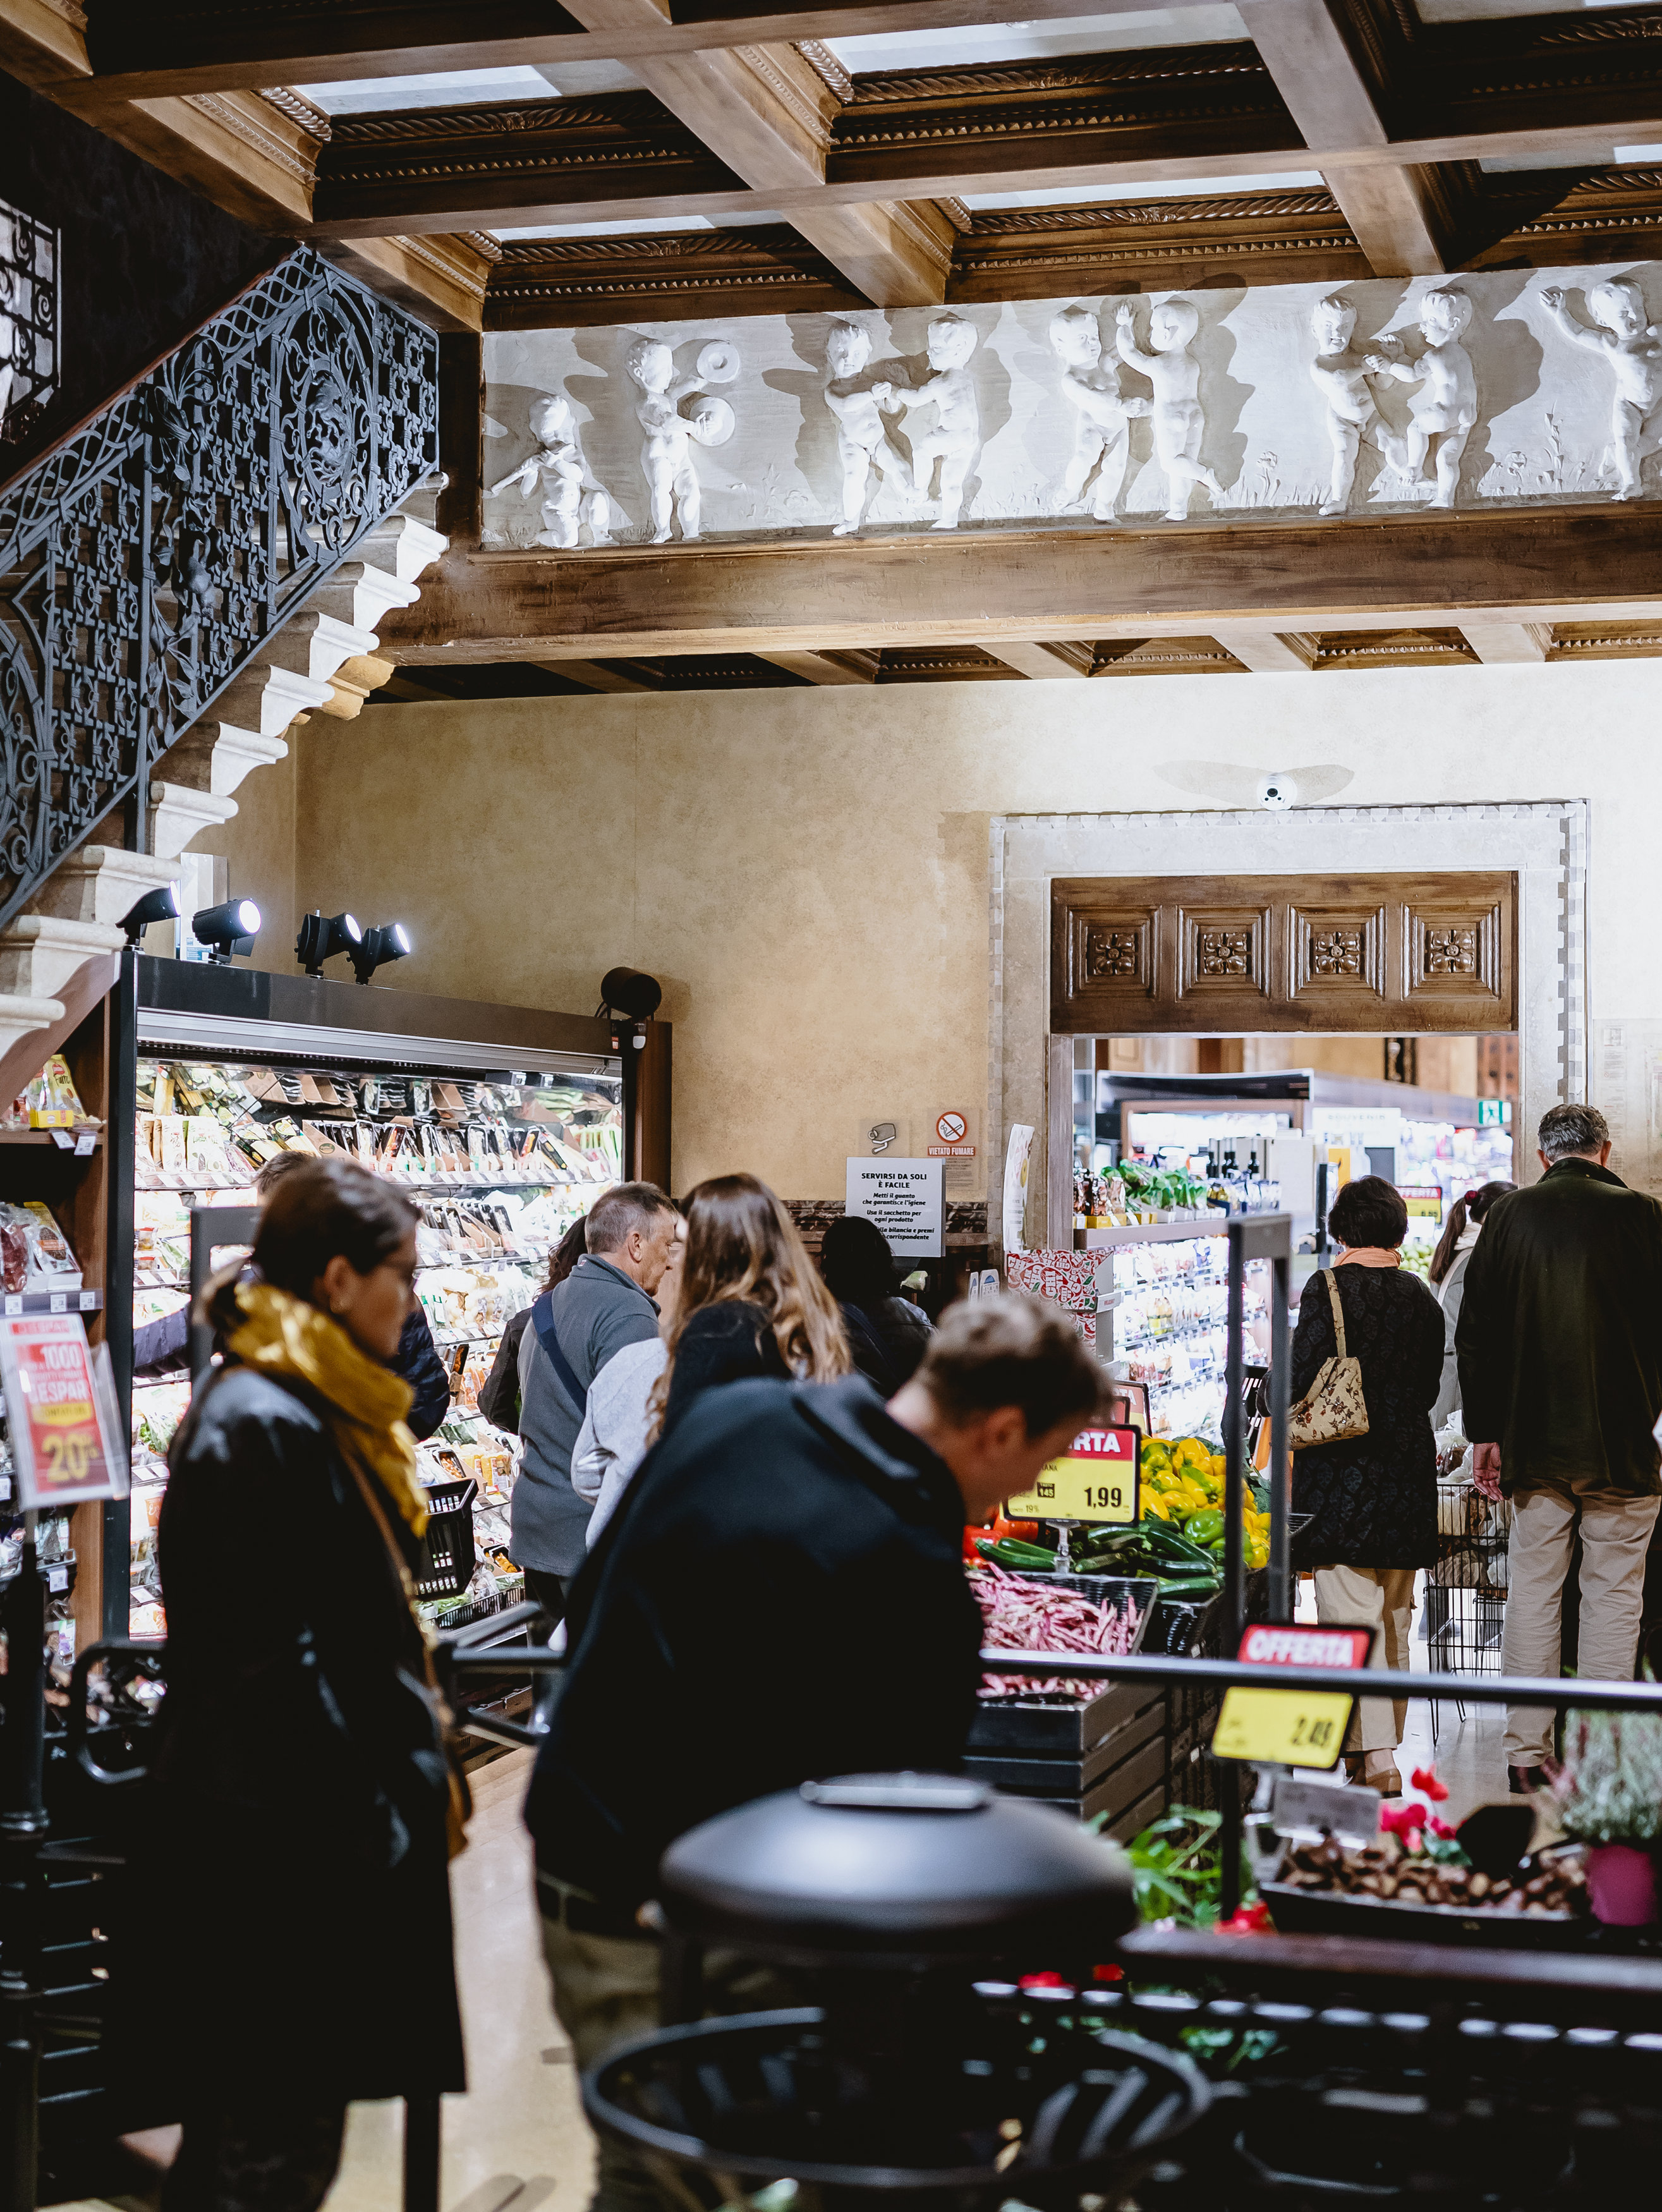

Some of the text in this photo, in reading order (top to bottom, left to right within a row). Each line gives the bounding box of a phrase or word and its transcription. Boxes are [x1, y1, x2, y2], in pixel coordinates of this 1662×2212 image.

[928, 1147, 974, 1155] VIETATO FUMARE
[878, 1180, 883, 1188] È
[1069, 1431, 1121, 1452] RTA
[1039, 1487, 1122, 1509] 145 1,99
[1247, 1631, 1354, 1667] OFFERTA
